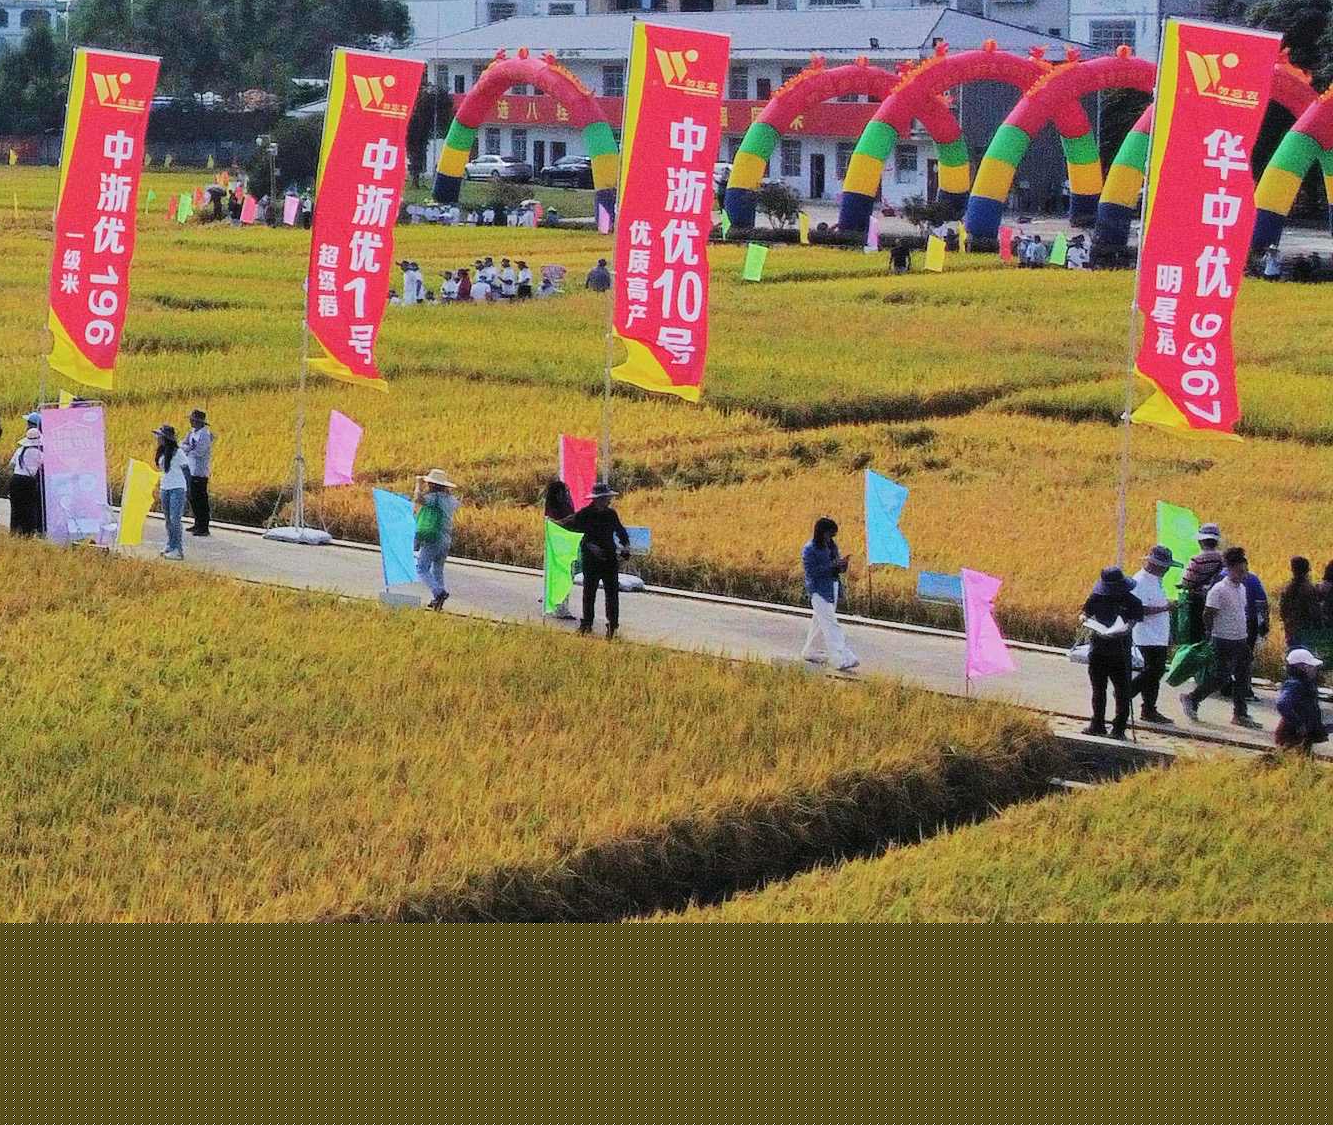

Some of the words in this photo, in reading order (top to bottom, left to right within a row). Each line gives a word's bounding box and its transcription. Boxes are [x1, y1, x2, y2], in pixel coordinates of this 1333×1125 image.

[60, 231, 85, 294] 一级米
[84, 130, 134, 346] 中浙优196
[317, 243, 339, 317] 超级稻
[343, 138, 399, 365] 中浙优1号
[625, 220, 653, 329] 优质高产
[653, 116, 708, 365] 中浙优10号
[1150, 264, 1183, 356] 明星稻
[1181, 128, 1250, 424] 华中优9367
